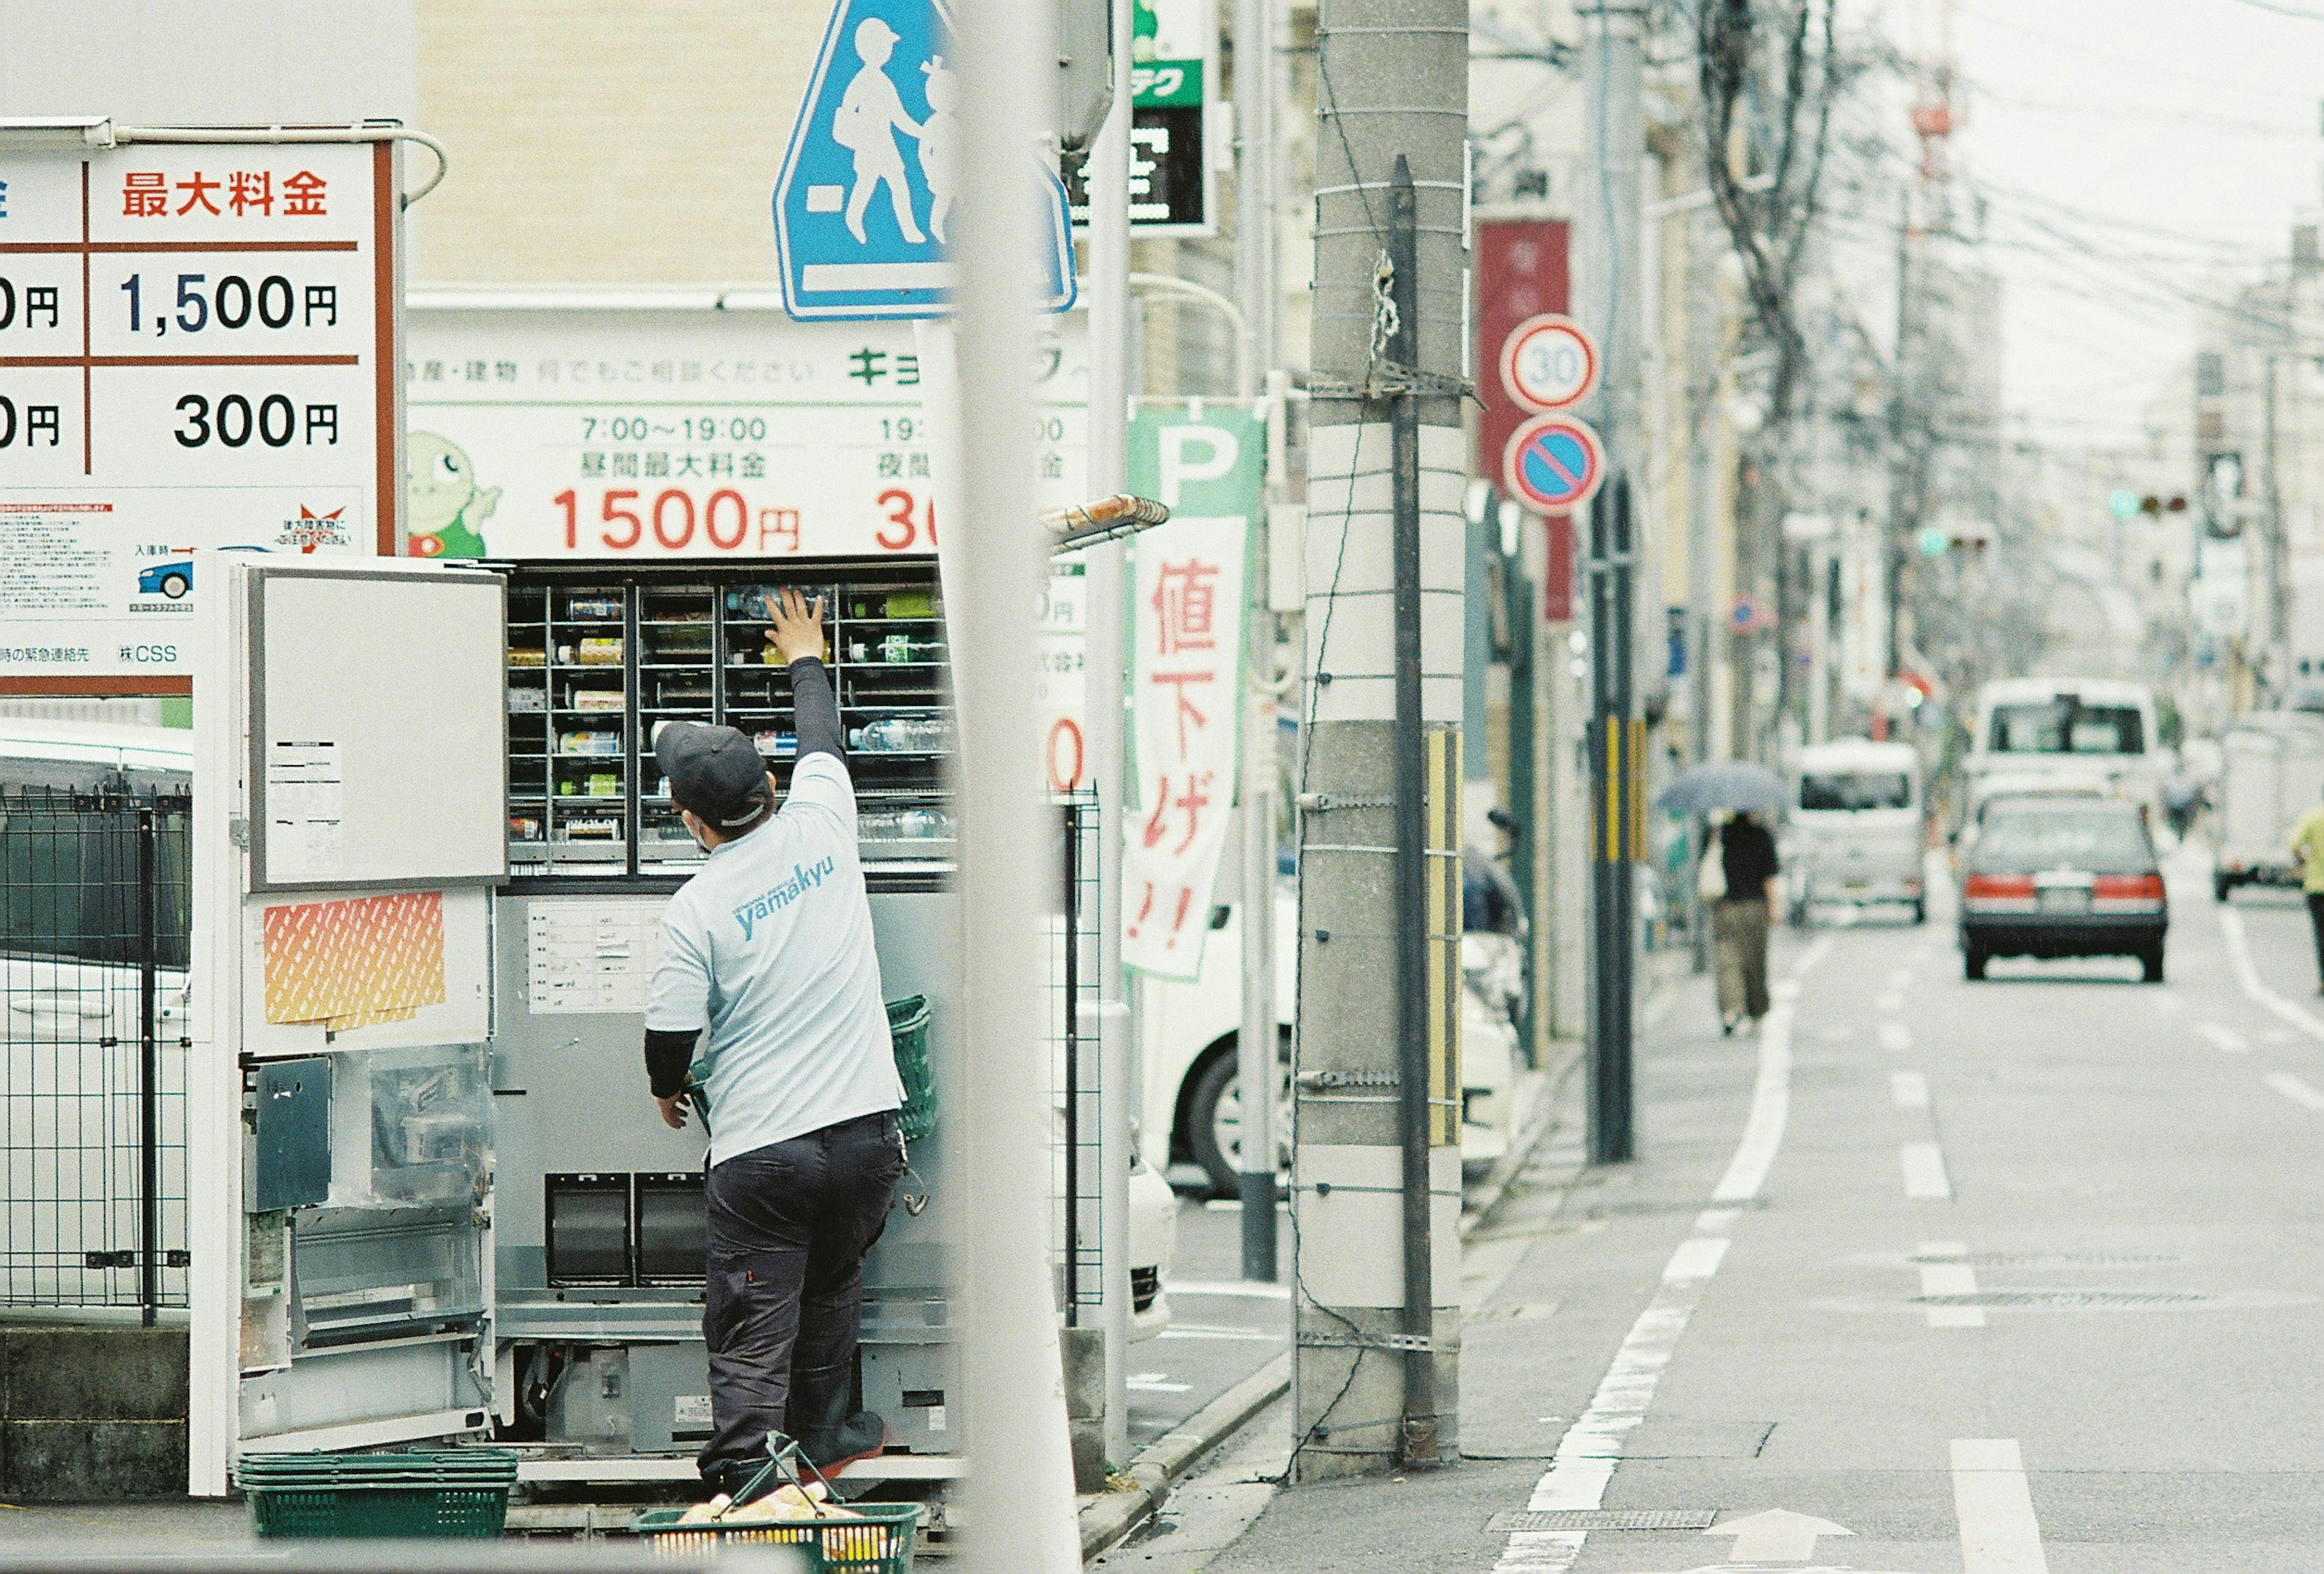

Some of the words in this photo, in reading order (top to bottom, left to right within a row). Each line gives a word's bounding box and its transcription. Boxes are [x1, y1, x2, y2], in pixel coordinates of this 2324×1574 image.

[122, 171, 327, 217] 最大料金
[120, 274, 336, 337] 1,500円
[1529, 345, 1578, 386] 30
[174, 394, 338, 447] 300円
[1158, 425, 1238, 510] P
[554, 488, 799, 552] 1500円
[135, 545, 169, 556] 入庫時
